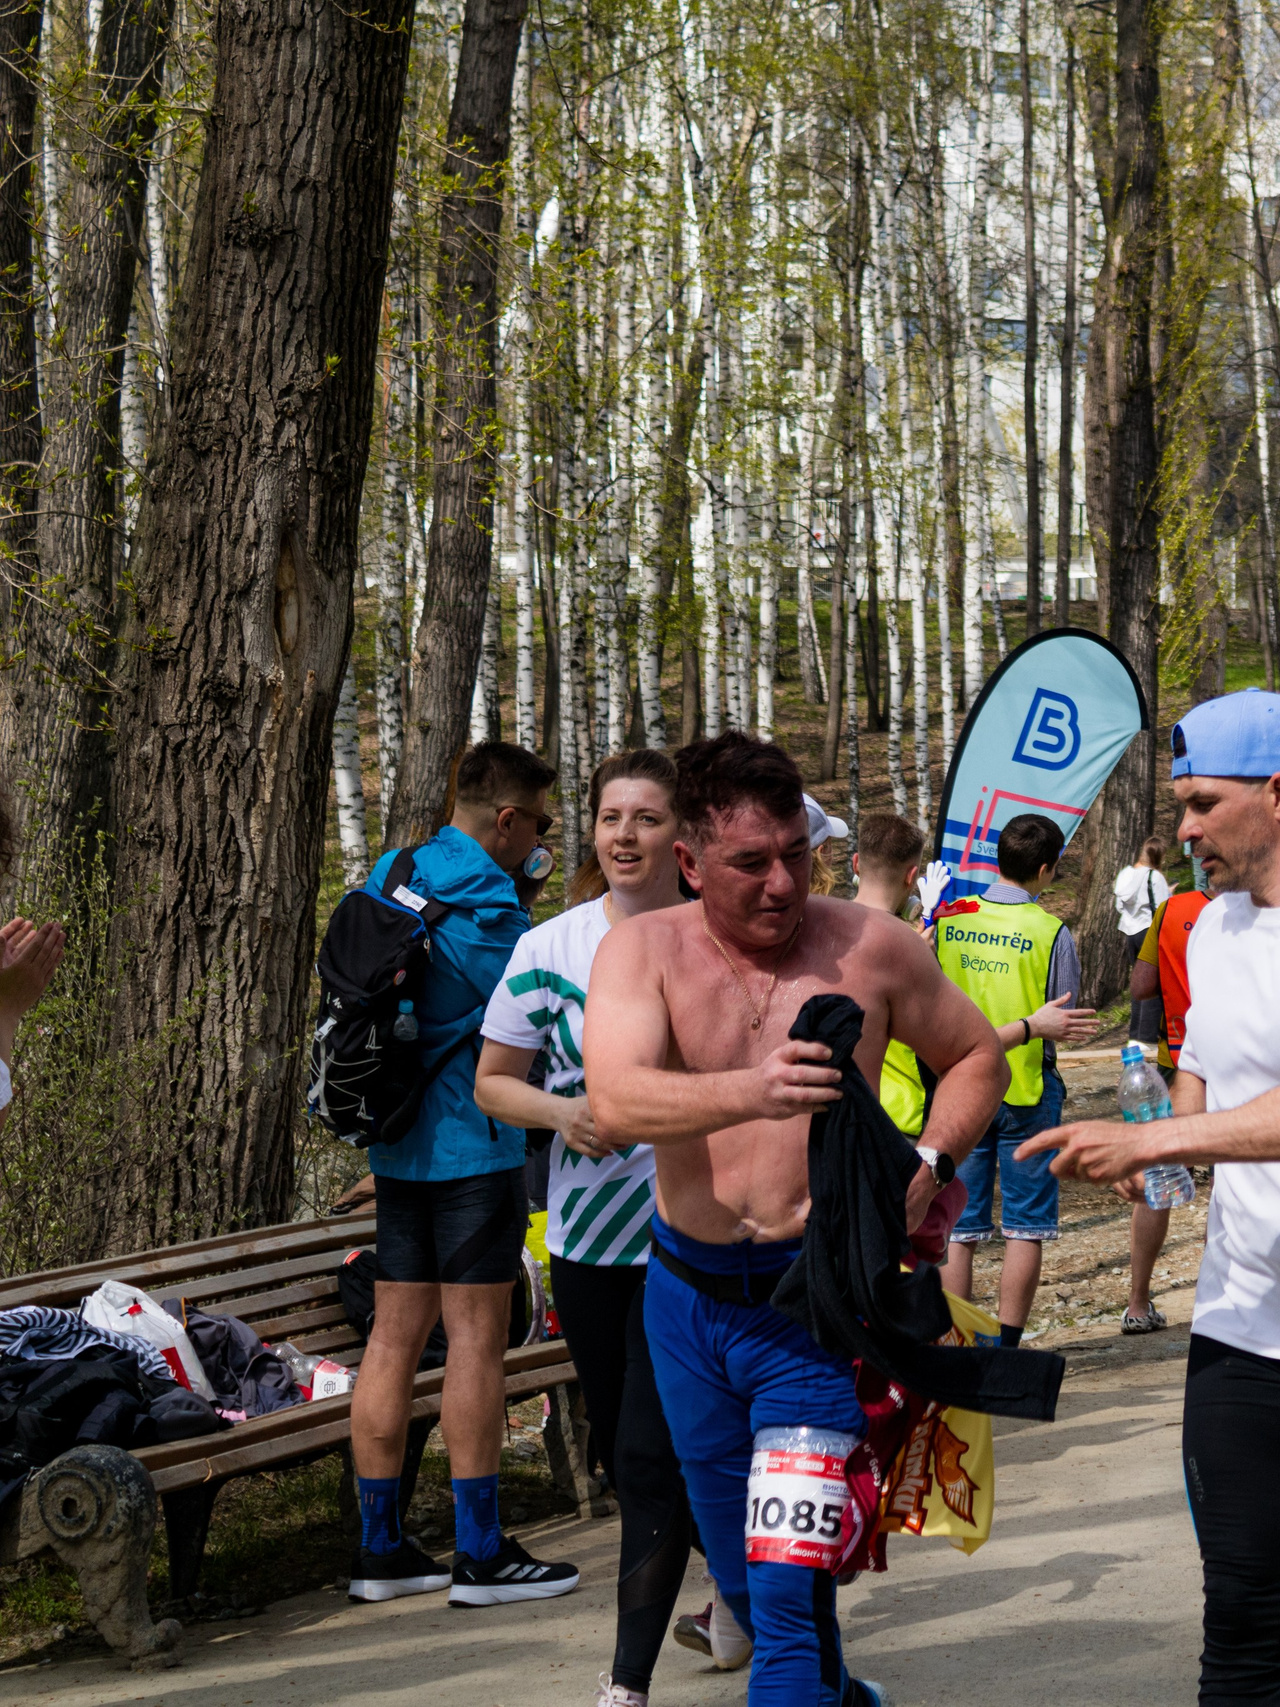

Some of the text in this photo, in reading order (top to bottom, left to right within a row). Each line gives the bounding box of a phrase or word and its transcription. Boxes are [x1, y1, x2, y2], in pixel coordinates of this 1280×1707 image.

[976, 842, 999, 857] 5ver
[945, 925, 1034, 954] Волонтёр
[822, 1483, 849, 1495] ВИКТО
[751, 1496, 843, 1539] 1085
